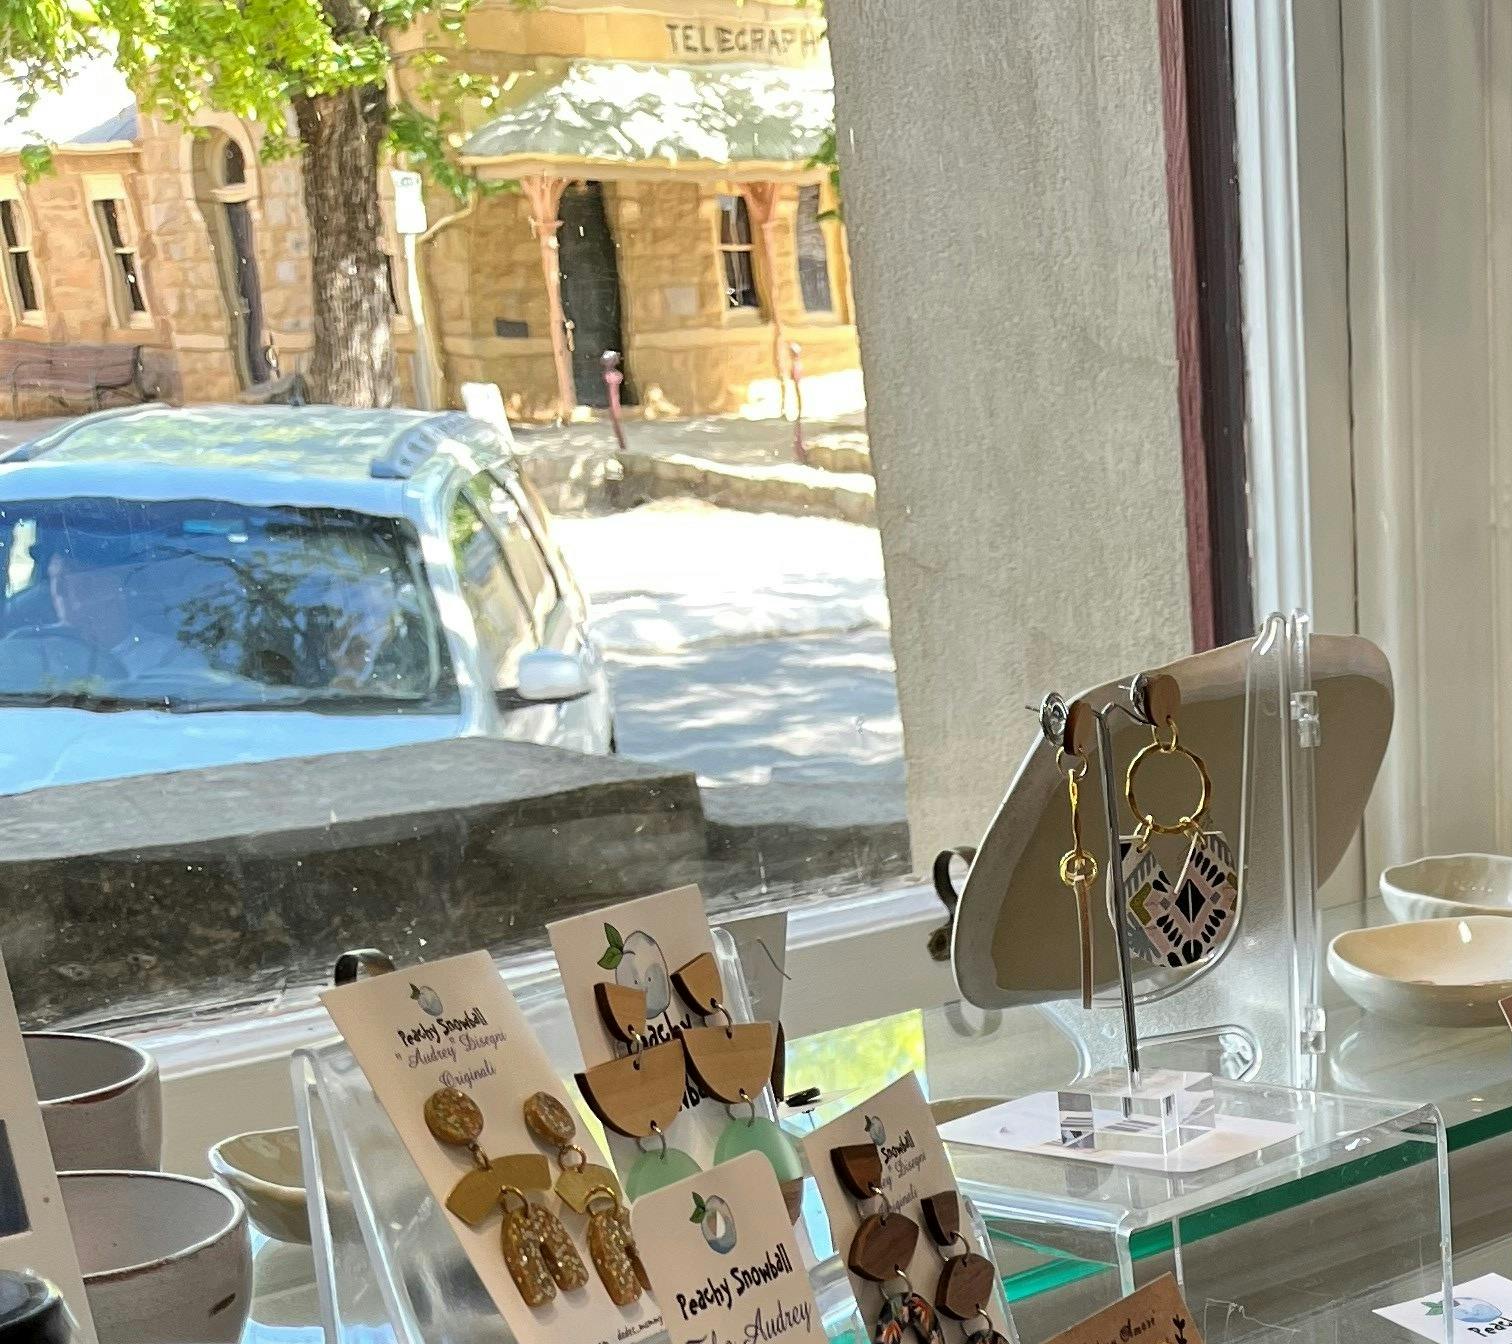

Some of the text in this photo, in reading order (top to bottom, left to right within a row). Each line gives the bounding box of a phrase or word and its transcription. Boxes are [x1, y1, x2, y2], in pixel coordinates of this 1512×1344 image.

[398, 1006, 489, 1047] Peachy Snowball
[675, 1242, 794, 1321] Peachy Snowball
